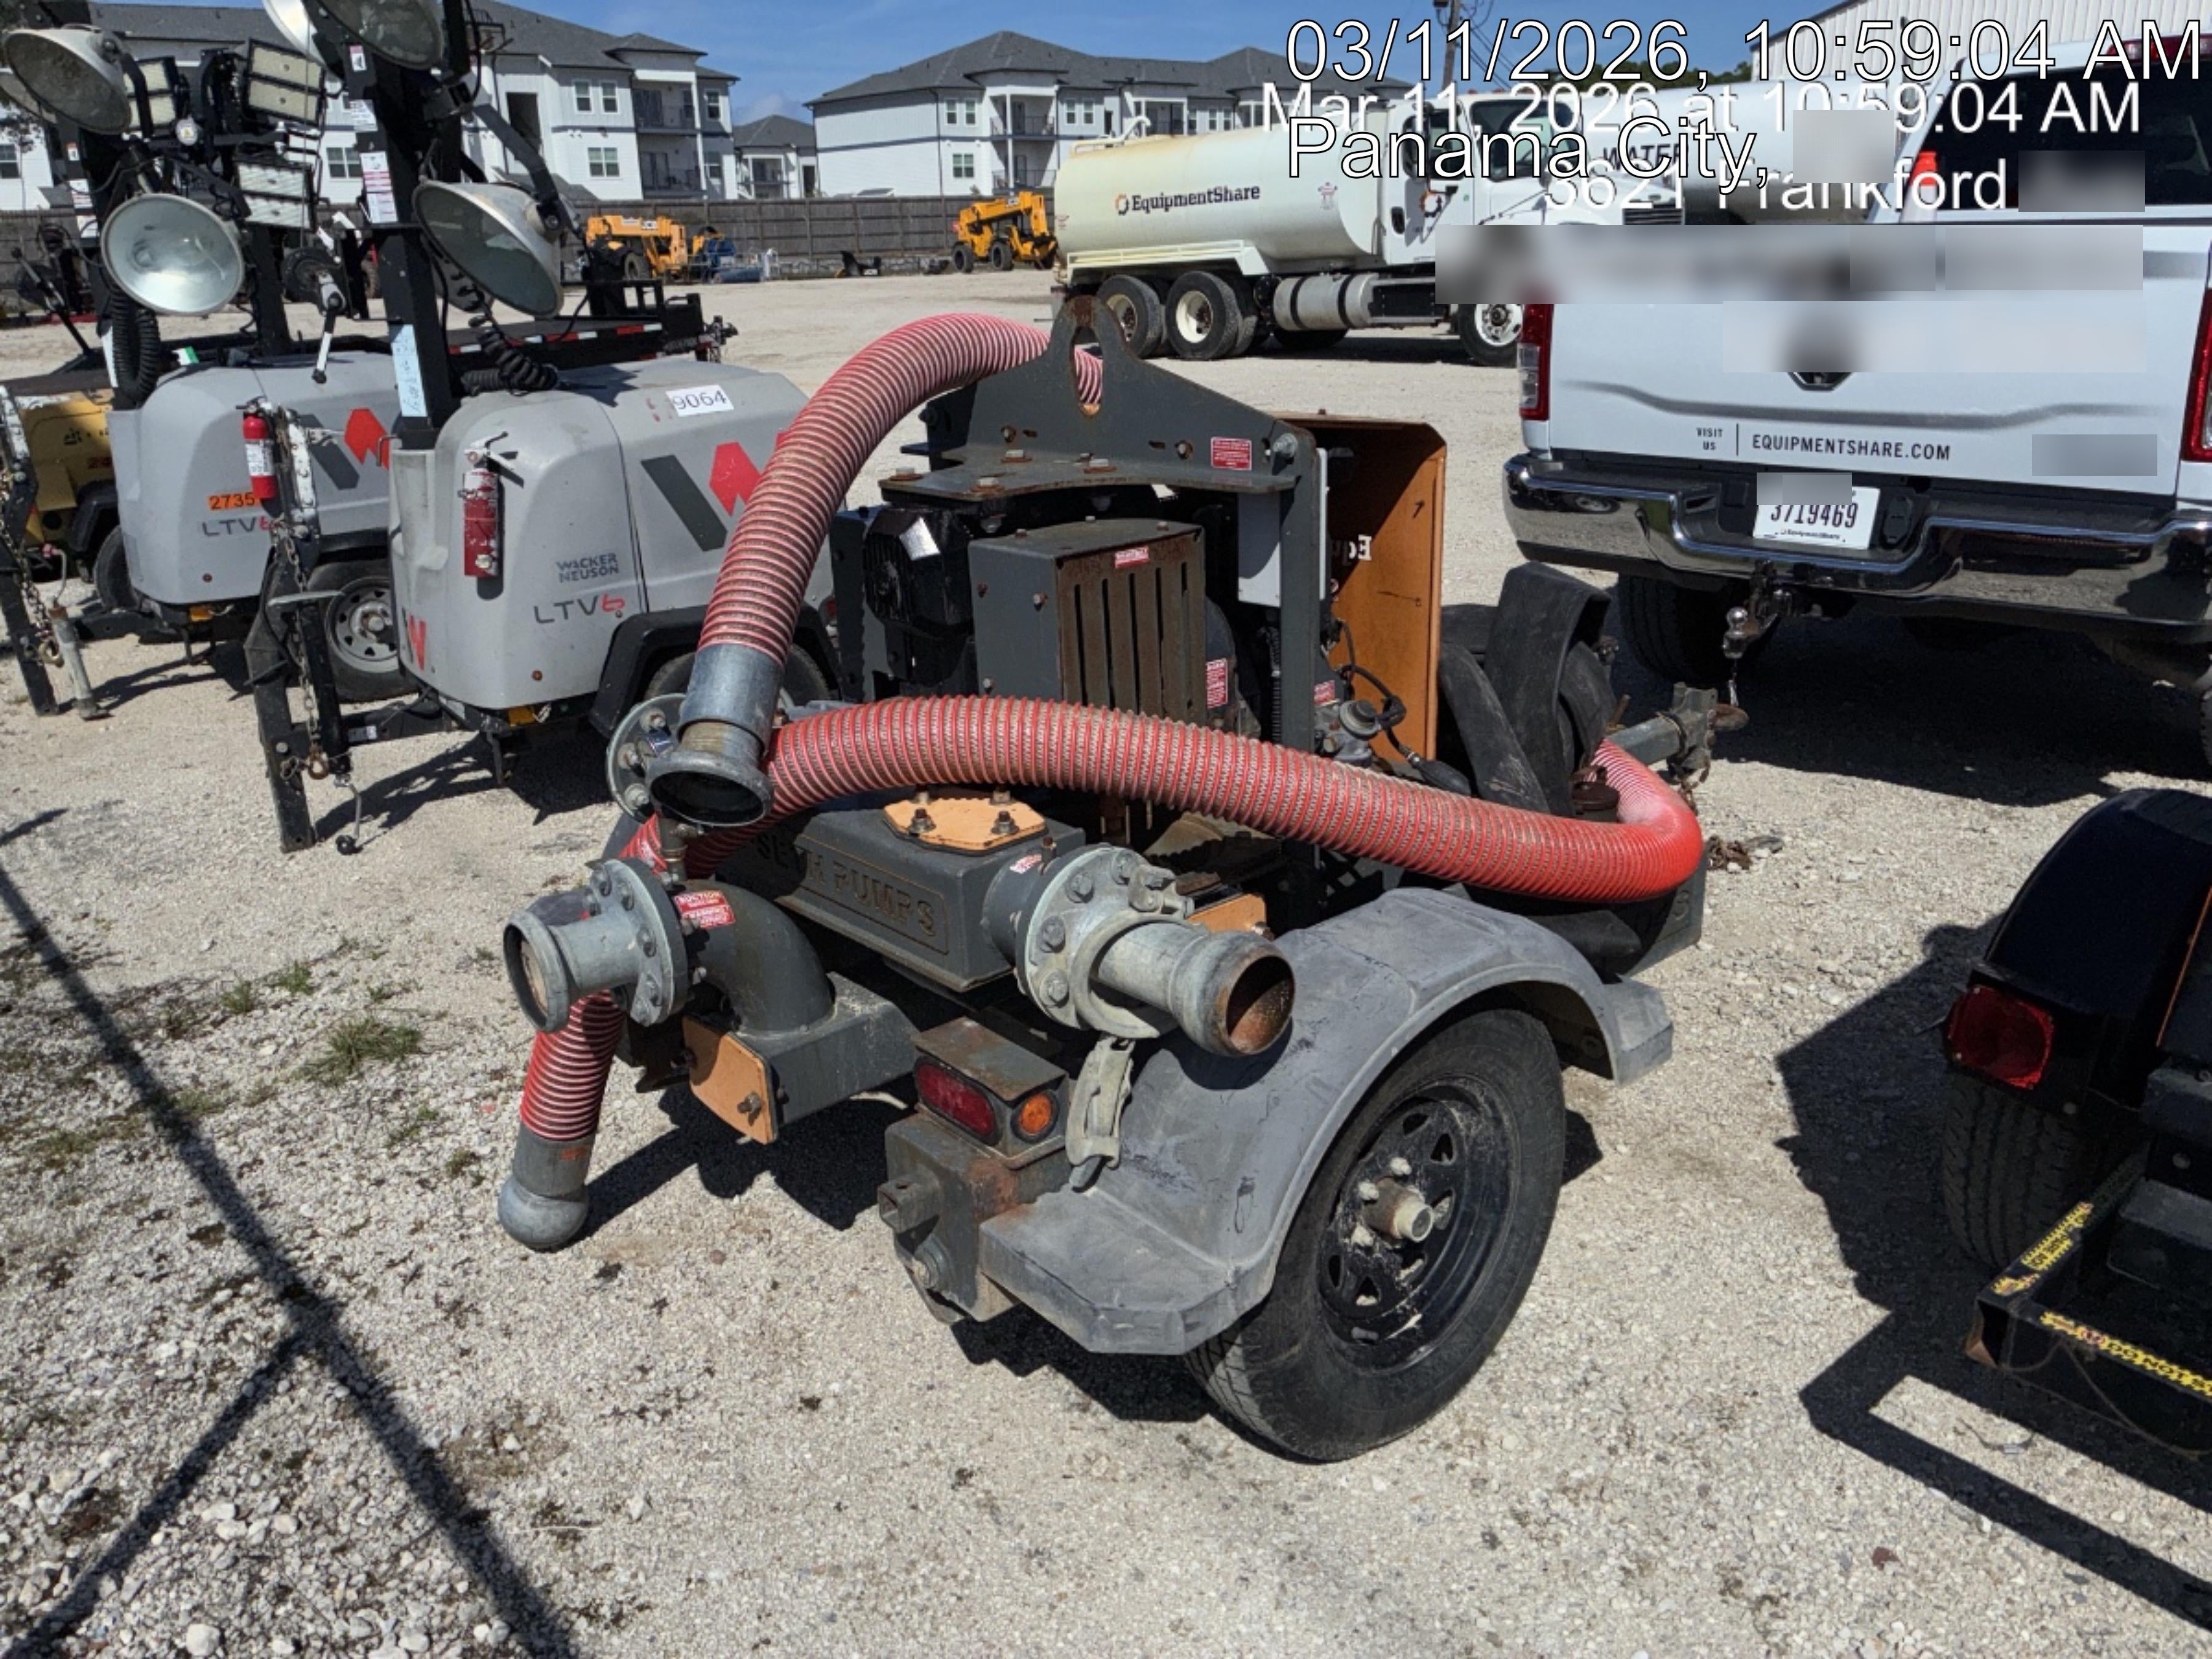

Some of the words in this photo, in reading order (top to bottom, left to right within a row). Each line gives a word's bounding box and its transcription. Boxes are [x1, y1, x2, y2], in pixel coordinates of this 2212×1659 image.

[1131, 185, 1260, 214] EquipmentShare
[672, 390, 726, 410] 9064
[1695, 427, 1724, 438] VISIT
[1703, 441, 1717, 451] US
[1752, 433, 1951, 461] EQUIPMENTSHARE.COM
[556, 553, 619, 571] WACKER
[559, 565, 619, 584] NEUSON
[533, 593, 626, 624] LTV6
[833, 860, 936, 937] PUMPS
